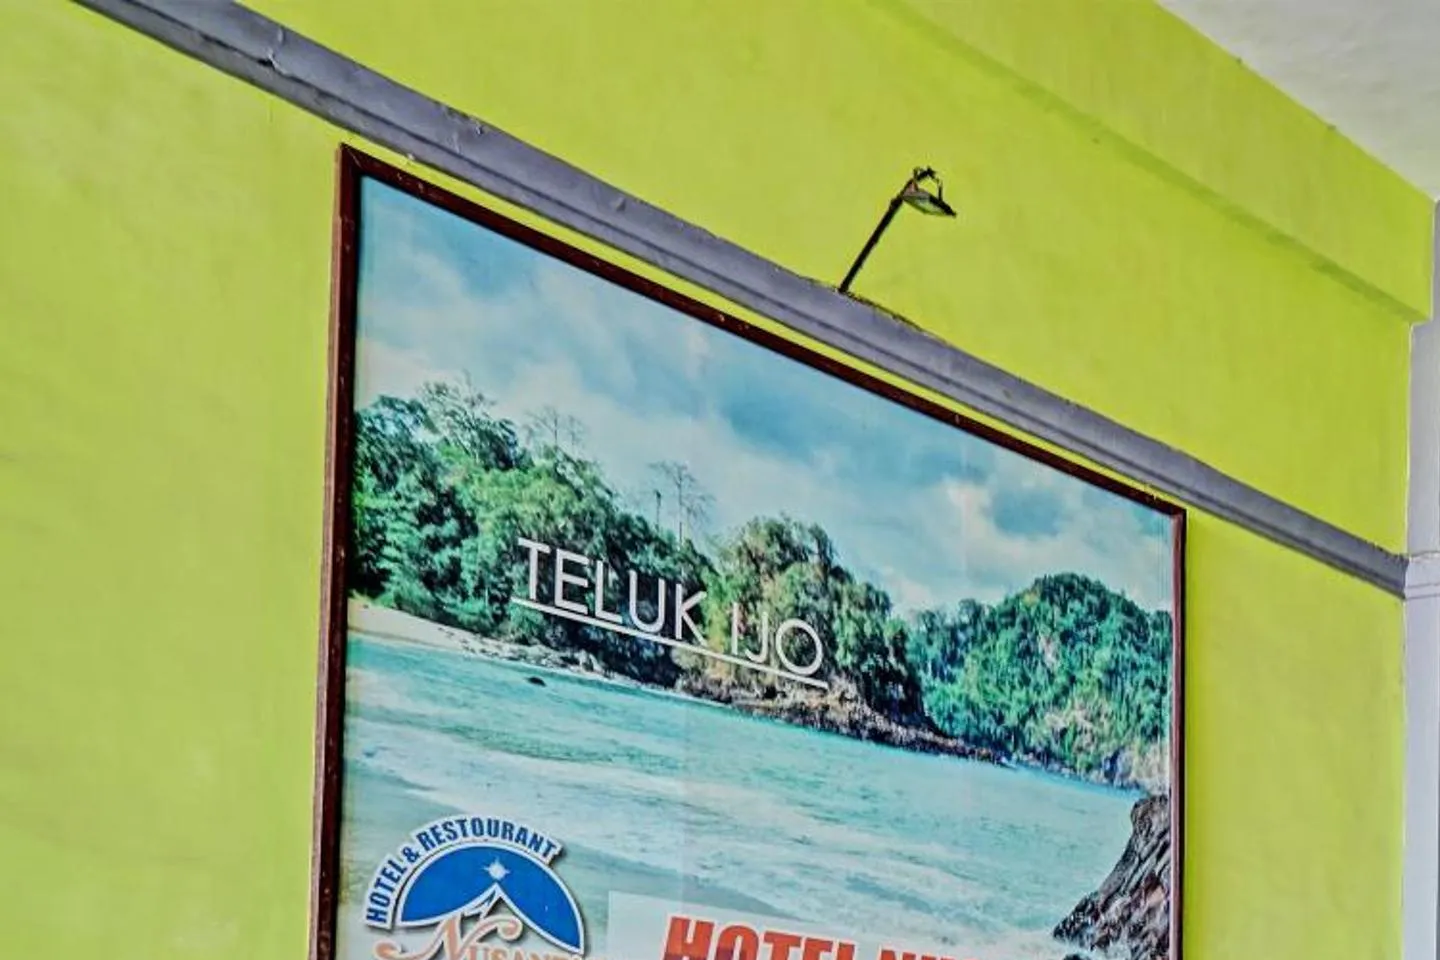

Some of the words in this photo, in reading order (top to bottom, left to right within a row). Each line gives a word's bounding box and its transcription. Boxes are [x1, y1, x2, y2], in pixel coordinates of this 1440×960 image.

[517, 537, 708, 648] TELUK
[730, 602, 824, 677] IJO
[366, 859, 406, 924] HOTEL
[401, 847, 420, 864] &
[416, 816, 560, 860] RESTOURANT
